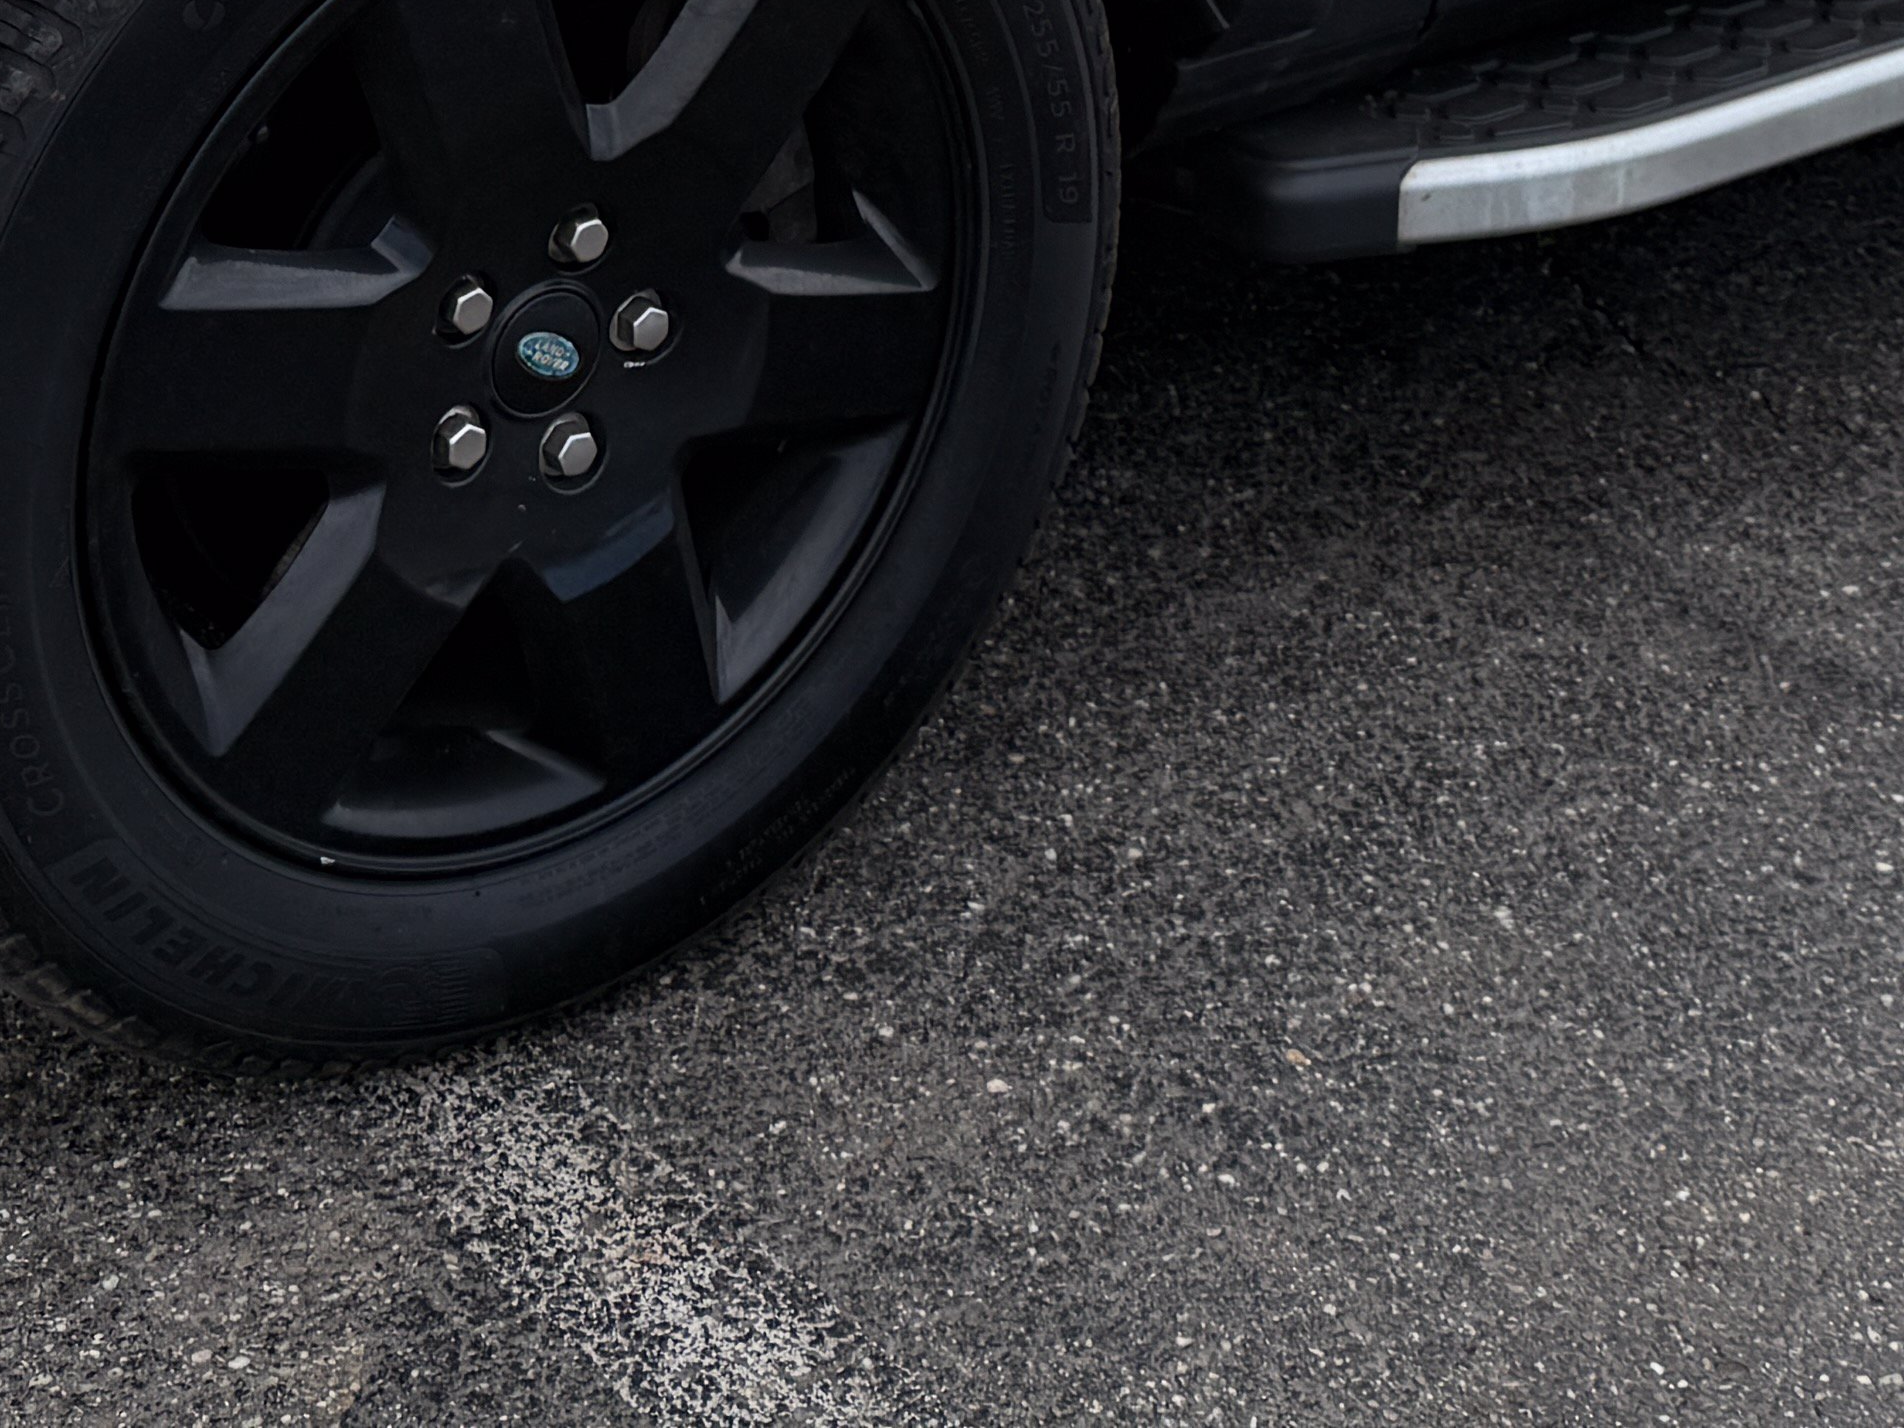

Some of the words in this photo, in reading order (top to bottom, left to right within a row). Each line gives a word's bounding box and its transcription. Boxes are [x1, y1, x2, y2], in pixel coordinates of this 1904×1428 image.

[1054, 132, 1077, 154] R
[1058, 171, 1080, 206] 19
[68, 855, 368, 1014] MICHELIN
